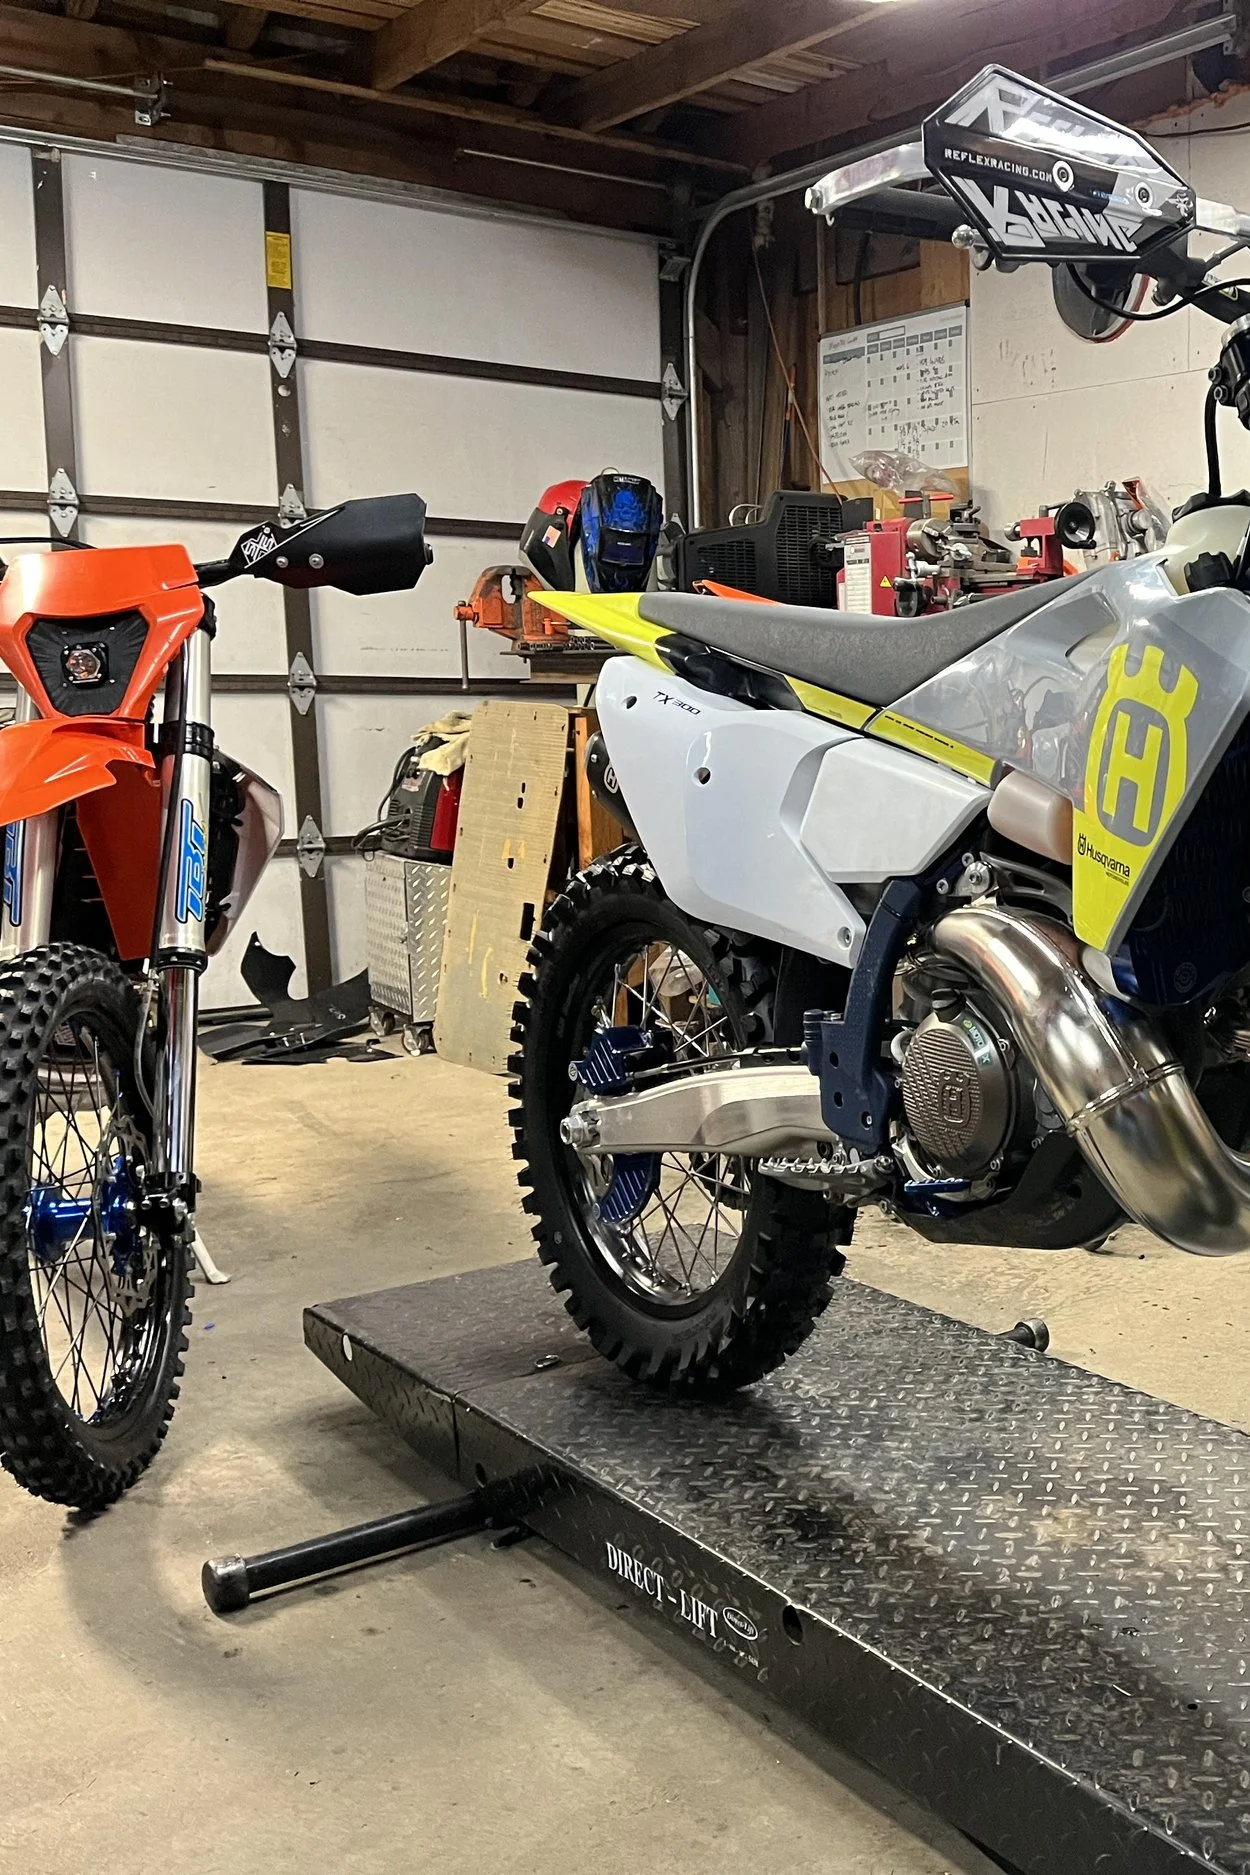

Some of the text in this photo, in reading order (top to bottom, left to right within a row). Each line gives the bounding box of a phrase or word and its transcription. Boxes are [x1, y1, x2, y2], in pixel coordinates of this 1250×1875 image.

[944, 148, 1053, 183] REFLEXRACING.COM
[653, 690, 701, 715] TX 300
[1086, 842, 1131, 877] Husqvarna
[606, 1541, 664, 1603] DIRECT
[680, 1588, 719, 1638] LIFT
